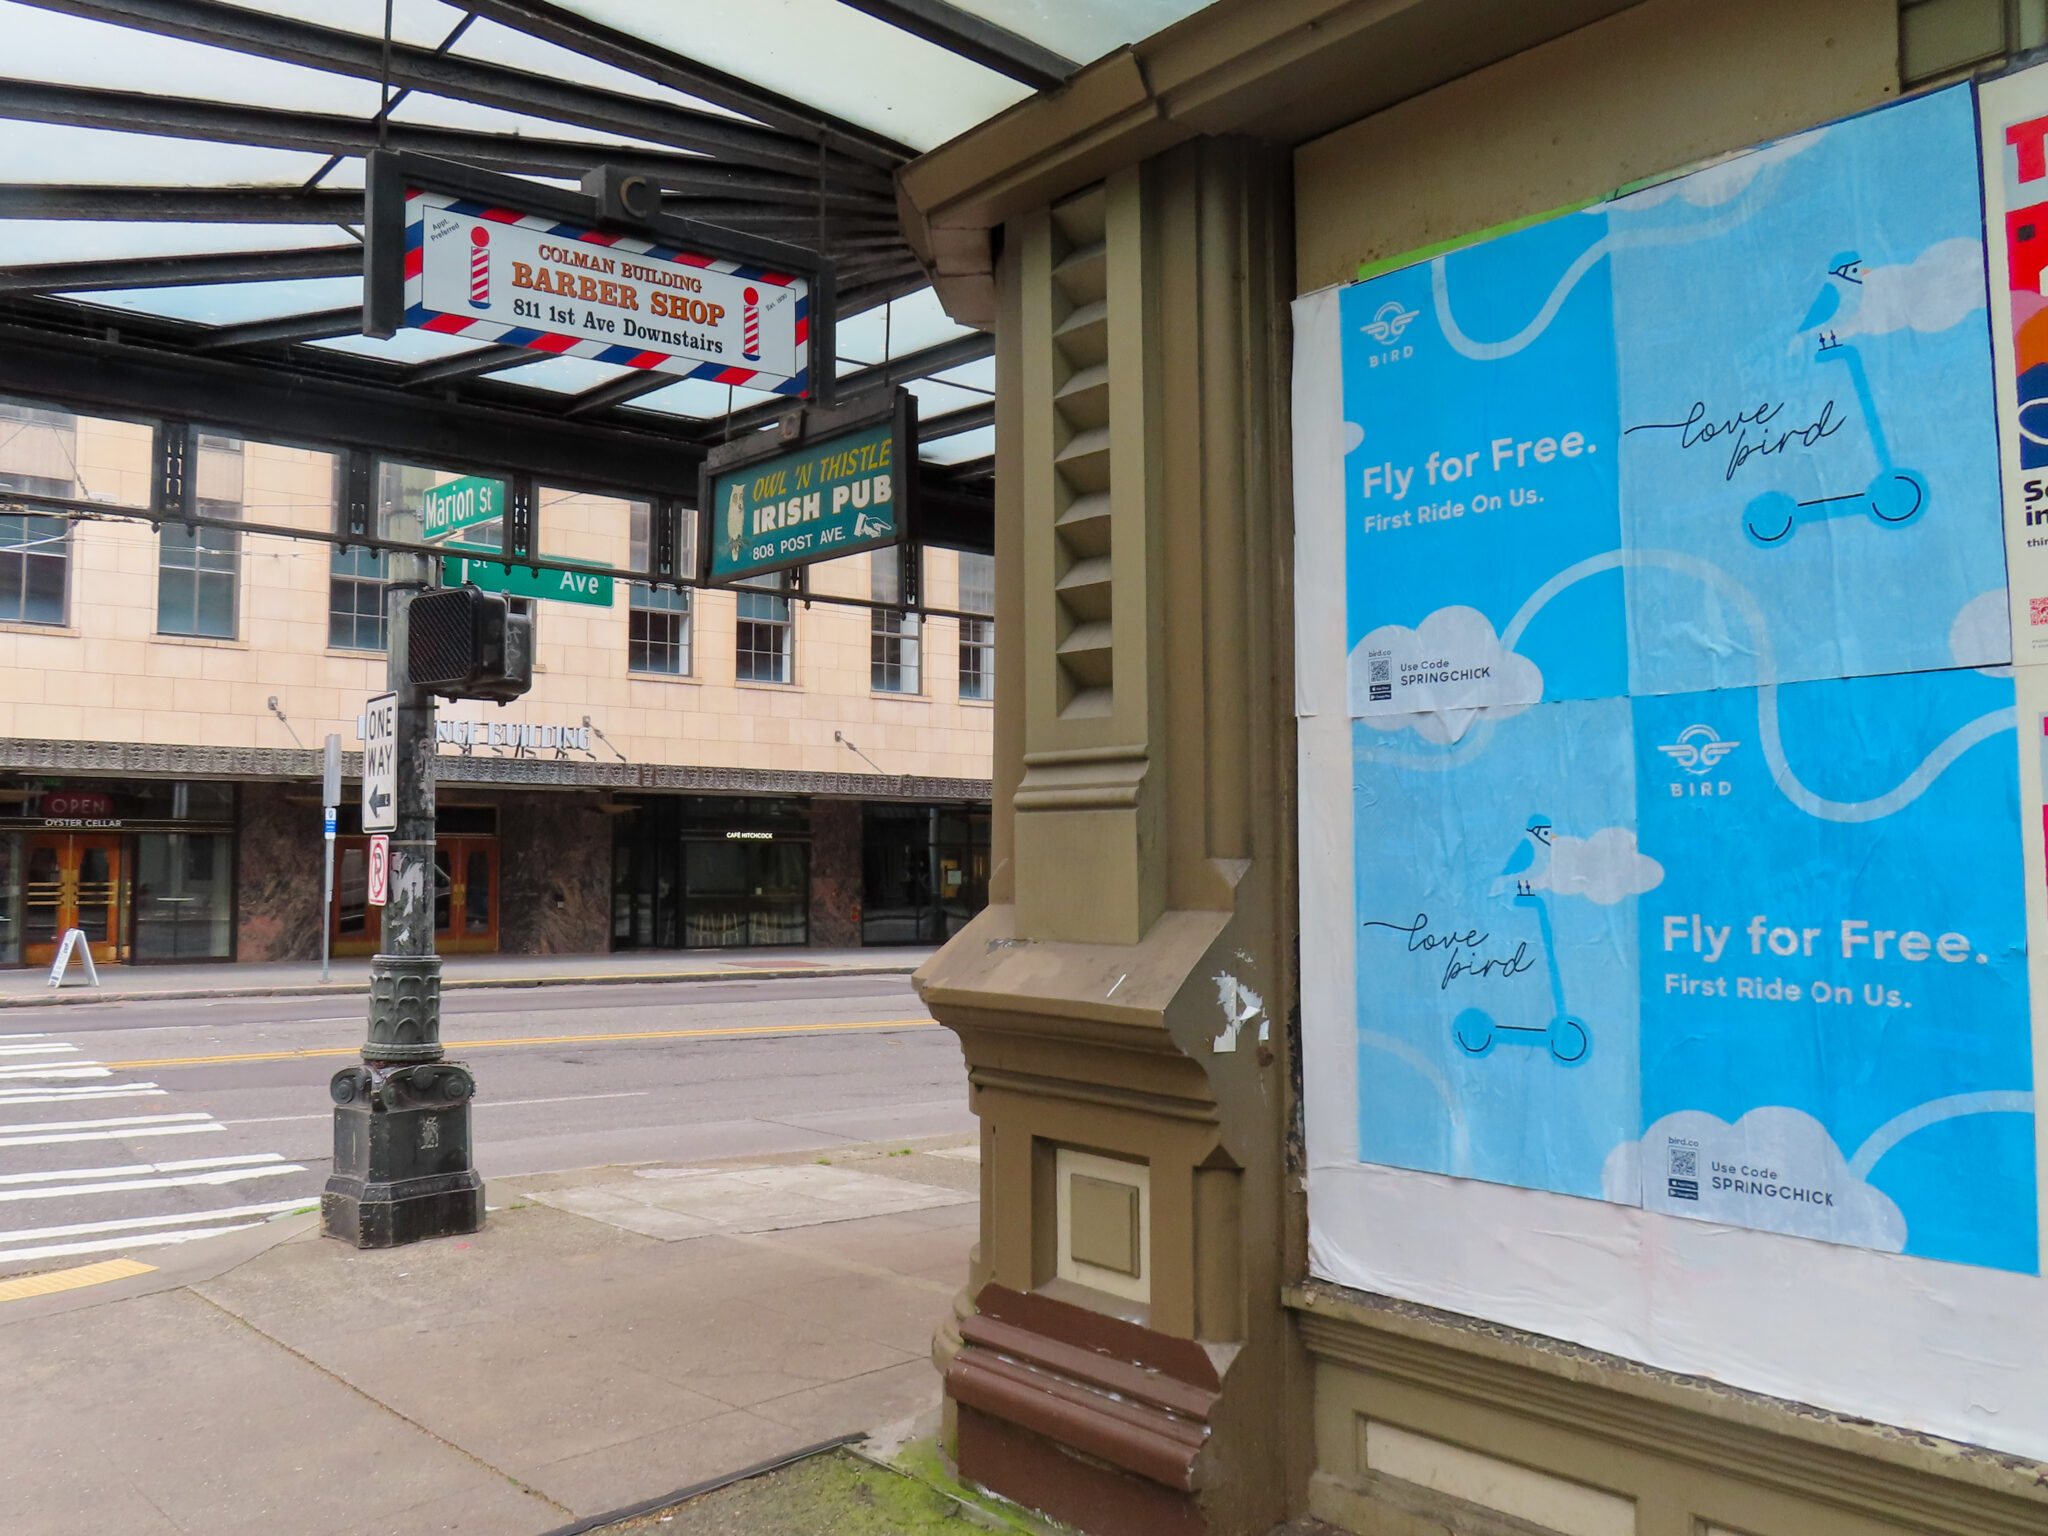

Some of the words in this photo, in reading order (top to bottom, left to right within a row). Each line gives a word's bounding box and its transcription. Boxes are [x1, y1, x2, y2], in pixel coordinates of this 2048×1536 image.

[430, 222, 460, 242] Preferred
[538, 244, 615, 274] COLMAN
[620, 262, 703, 293] BUILDING
[511, 261, 640, 311] BARBER
[651, 291, 725, 328] SHOP
[513, 298, 541, 319] 811
[549, 305, 575, 325] 1st
[583, 311, 615, 333] Ave
[623, 318, 724, 353] Downstairs
[1369, 345, 1414, 368] BIRD
[1624, 402, 1785, 448] love
[753, 470, 788, 502] OWL
[820, 438, 893, 484] THISTLE
[1363, 462, 1415, 501] Fly
[1425, 451, 1480, 486] for
[1491, 431, 1597, 472] Free.
[425, 485, 475, 531] Marion
[753, 492, 821, 536] IRISH
[832, 474, 893, 514] PUB
[1364, 509, 1412, 534] First
[1418, 500, 1465, 525] Ride
[1471, 494, 1502, 514] On
[1509, 488, 1545, 508] Us.
[752, 543, 775, 561] 808
[780, 533, 814, 553] POST
[819, 526, 846, 544] AVE.
[559, 571, 600, 594] Ave
[1368, 650, 1392, 658] bird.co
[1400, 662, 1419, 672] Use
[1421, 659, 1450, 670] Code
[1400, 666, 1491, 686] SPRINGCHICK
[368, 706, 393, 740] ONE
[488, 721, 591, 751] BUILDING
[366, 746, 393, 777] WAY
[1670, 781, 1732, 798] BIRD
[51, 798, 105, 814] OPEN
[45, 819, 83, 827] OYSTER
[86, 819, 122, 828] CELLAR
[1363, 913, 1490, 952] love
[1663, 914, 1732, 963] Fly
[1746, 915, 1822, 957] for
[1840, 919, 1989, 964] Free.
[1664, 973, 1728, 997] First
[1736, 976, 1802, 1002] Ride
[1811, 980, 1853, 1005] On
[1863, 983, 1912, 1009] Us.
[1668, 1136, 1699, 1148] bird.co
[1711, 1160, 1737, 1174] Use
[1740, 1165, 1778, 1180] Code
[1711, 1176, 1834, 1207] SPRINGCHICK
